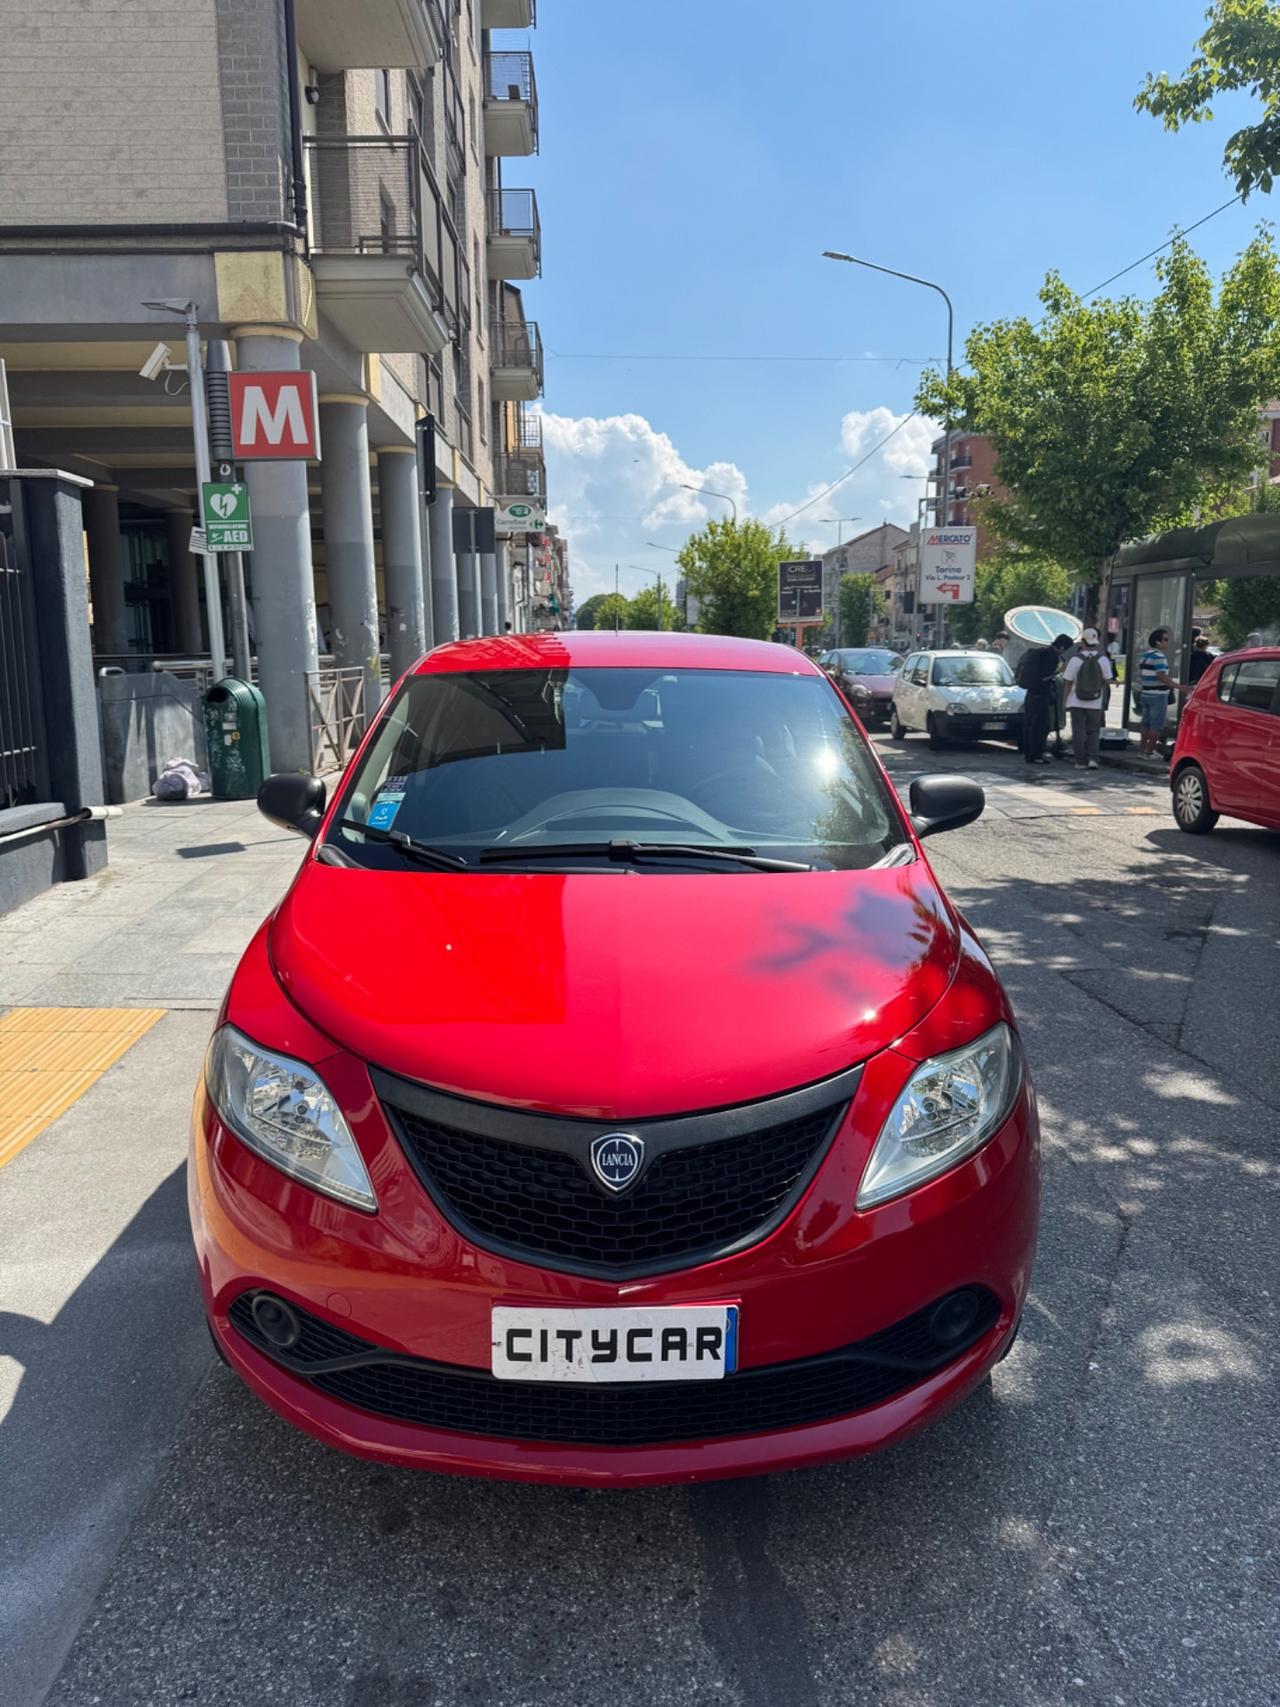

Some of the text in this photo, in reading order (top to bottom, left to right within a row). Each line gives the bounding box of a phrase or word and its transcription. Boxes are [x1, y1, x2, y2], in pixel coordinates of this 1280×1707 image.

[240, 385, 309, 445] M
[223, 530, 248, 543] AED
[927, 534, 971, 545] MERCATO
[935, 565, 962, 573] Torino
[602, 1153, 633, 1166] LANCIA
[506, 1326, 723, 1364] CITYCAR
